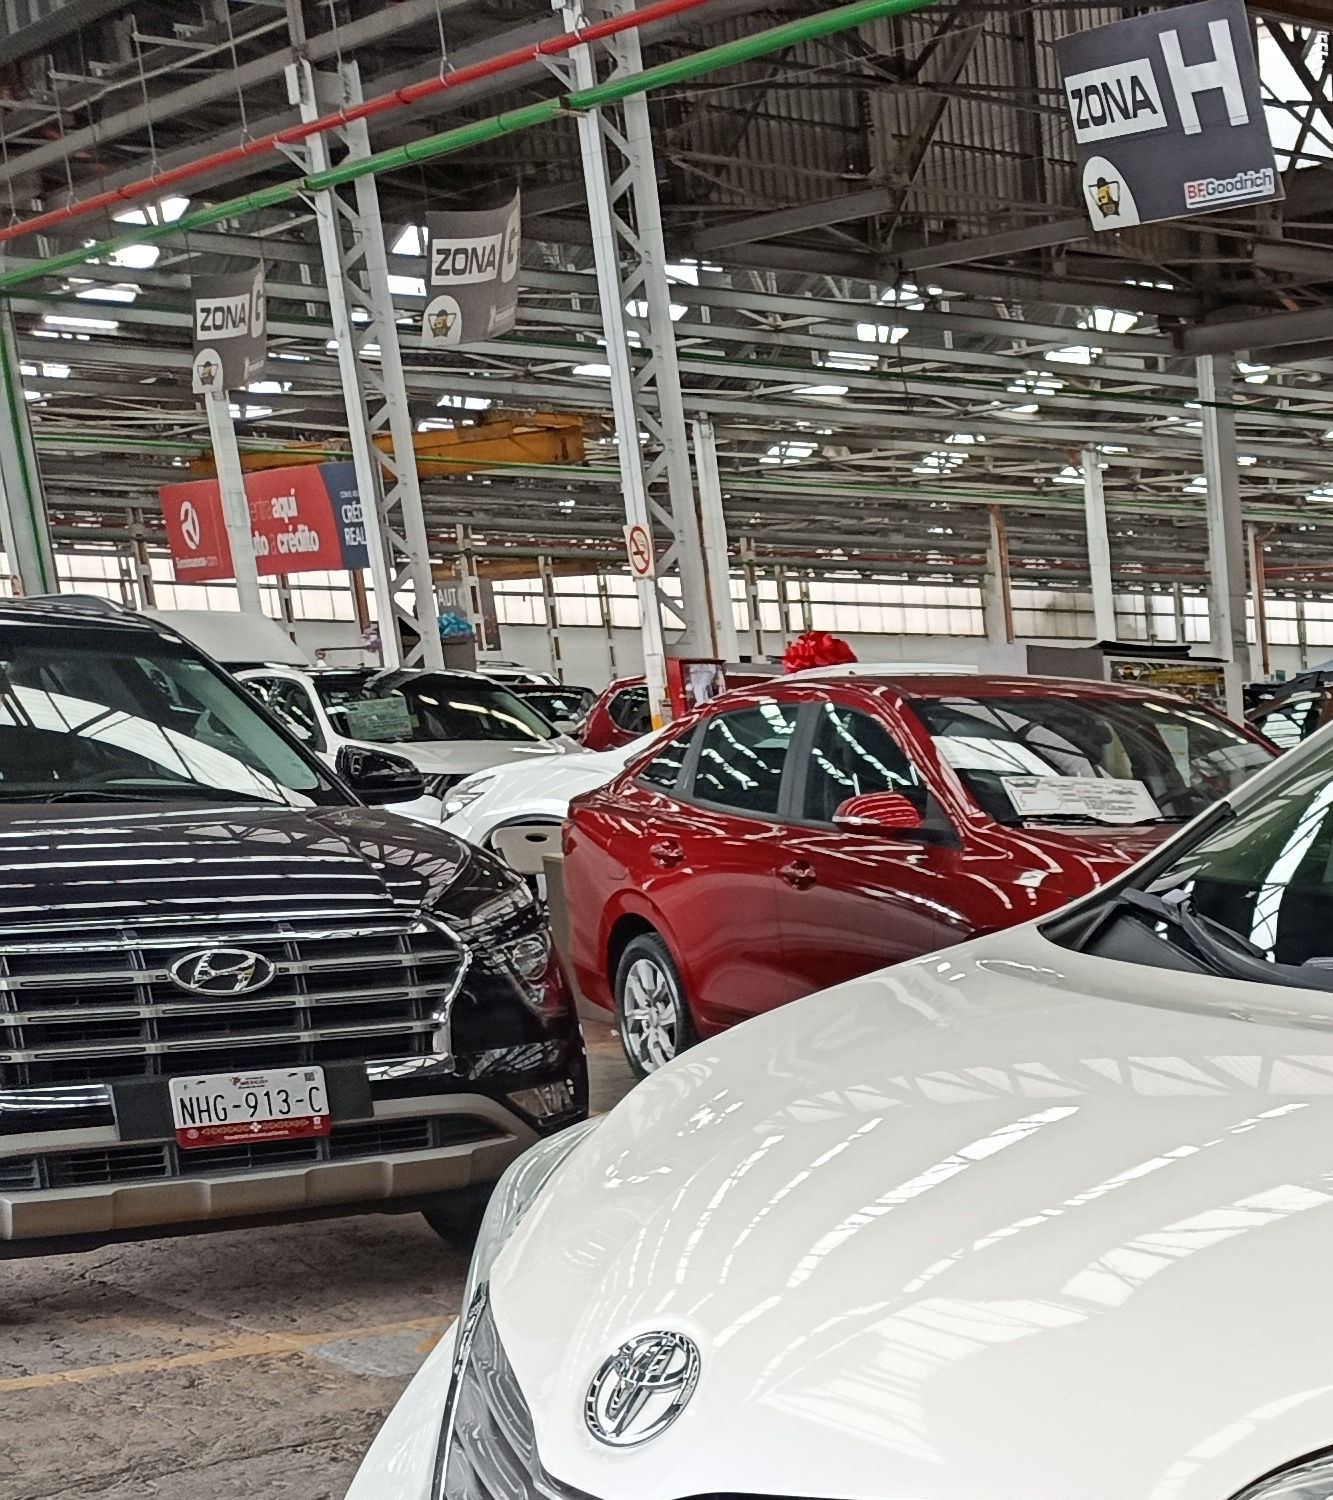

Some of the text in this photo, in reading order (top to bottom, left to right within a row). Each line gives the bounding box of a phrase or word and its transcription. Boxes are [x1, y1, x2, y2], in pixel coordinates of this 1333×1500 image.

[1071, 19, 1249, 135] ZONA H
[435, 207, 520, 283] ZONA G
[200, 272, 264, 338] ZONA G
[341, 501, 363, 523] CRÉD
[277, 525, 319, 553] crédito
[180, 1086, 322, 1125] NHG-913-C
